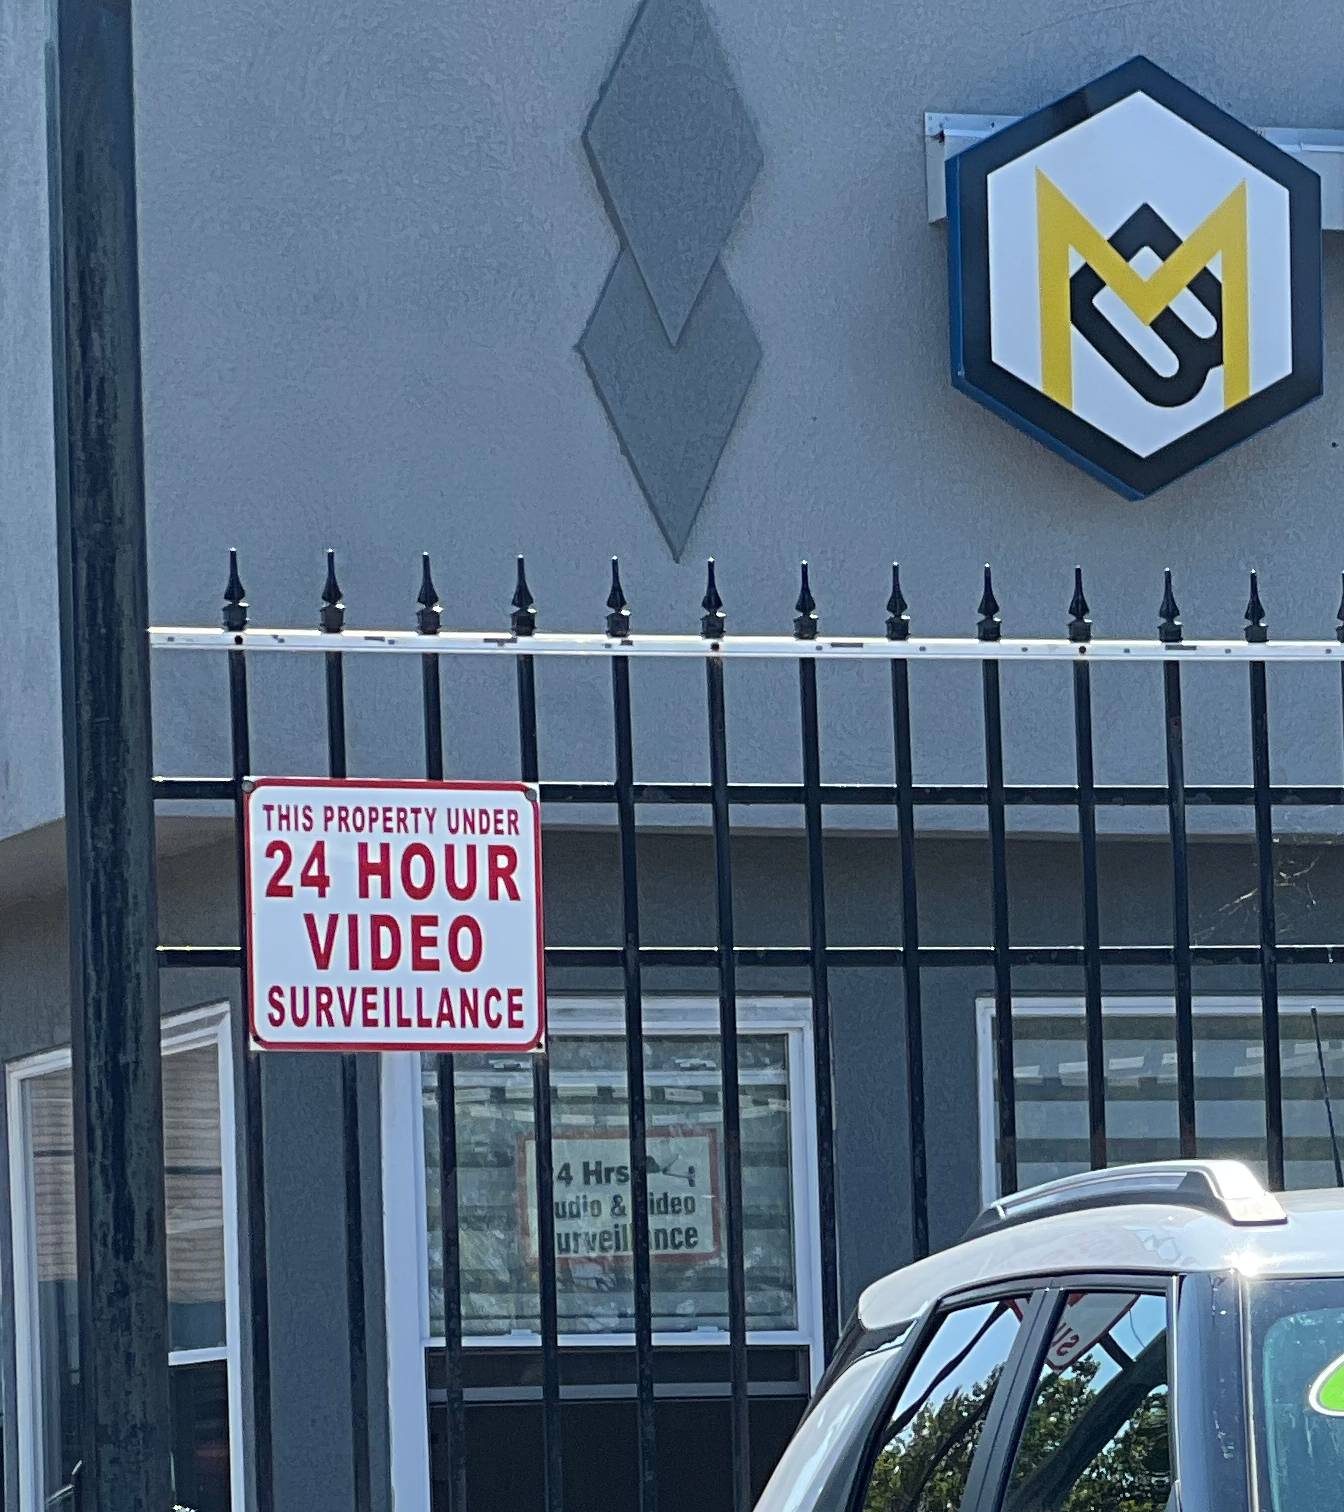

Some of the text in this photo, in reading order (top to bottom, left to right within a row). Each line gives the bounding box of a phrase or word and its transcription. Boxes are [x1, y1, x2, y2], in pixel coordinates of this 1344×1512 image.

[262, 804, 521, 836] THIS PROPERTY UNDER
[264, 839, 521, 901] 24 HOUR
[302, 913, 484, 973] VIDEO
[266, 985, 525, 1029] SURVEILLANCE
[582, 1161, 630, 1186] Hrs
[554, 1194, 602, 1219] udio
[650, 1192, 697, 1215] ideo
